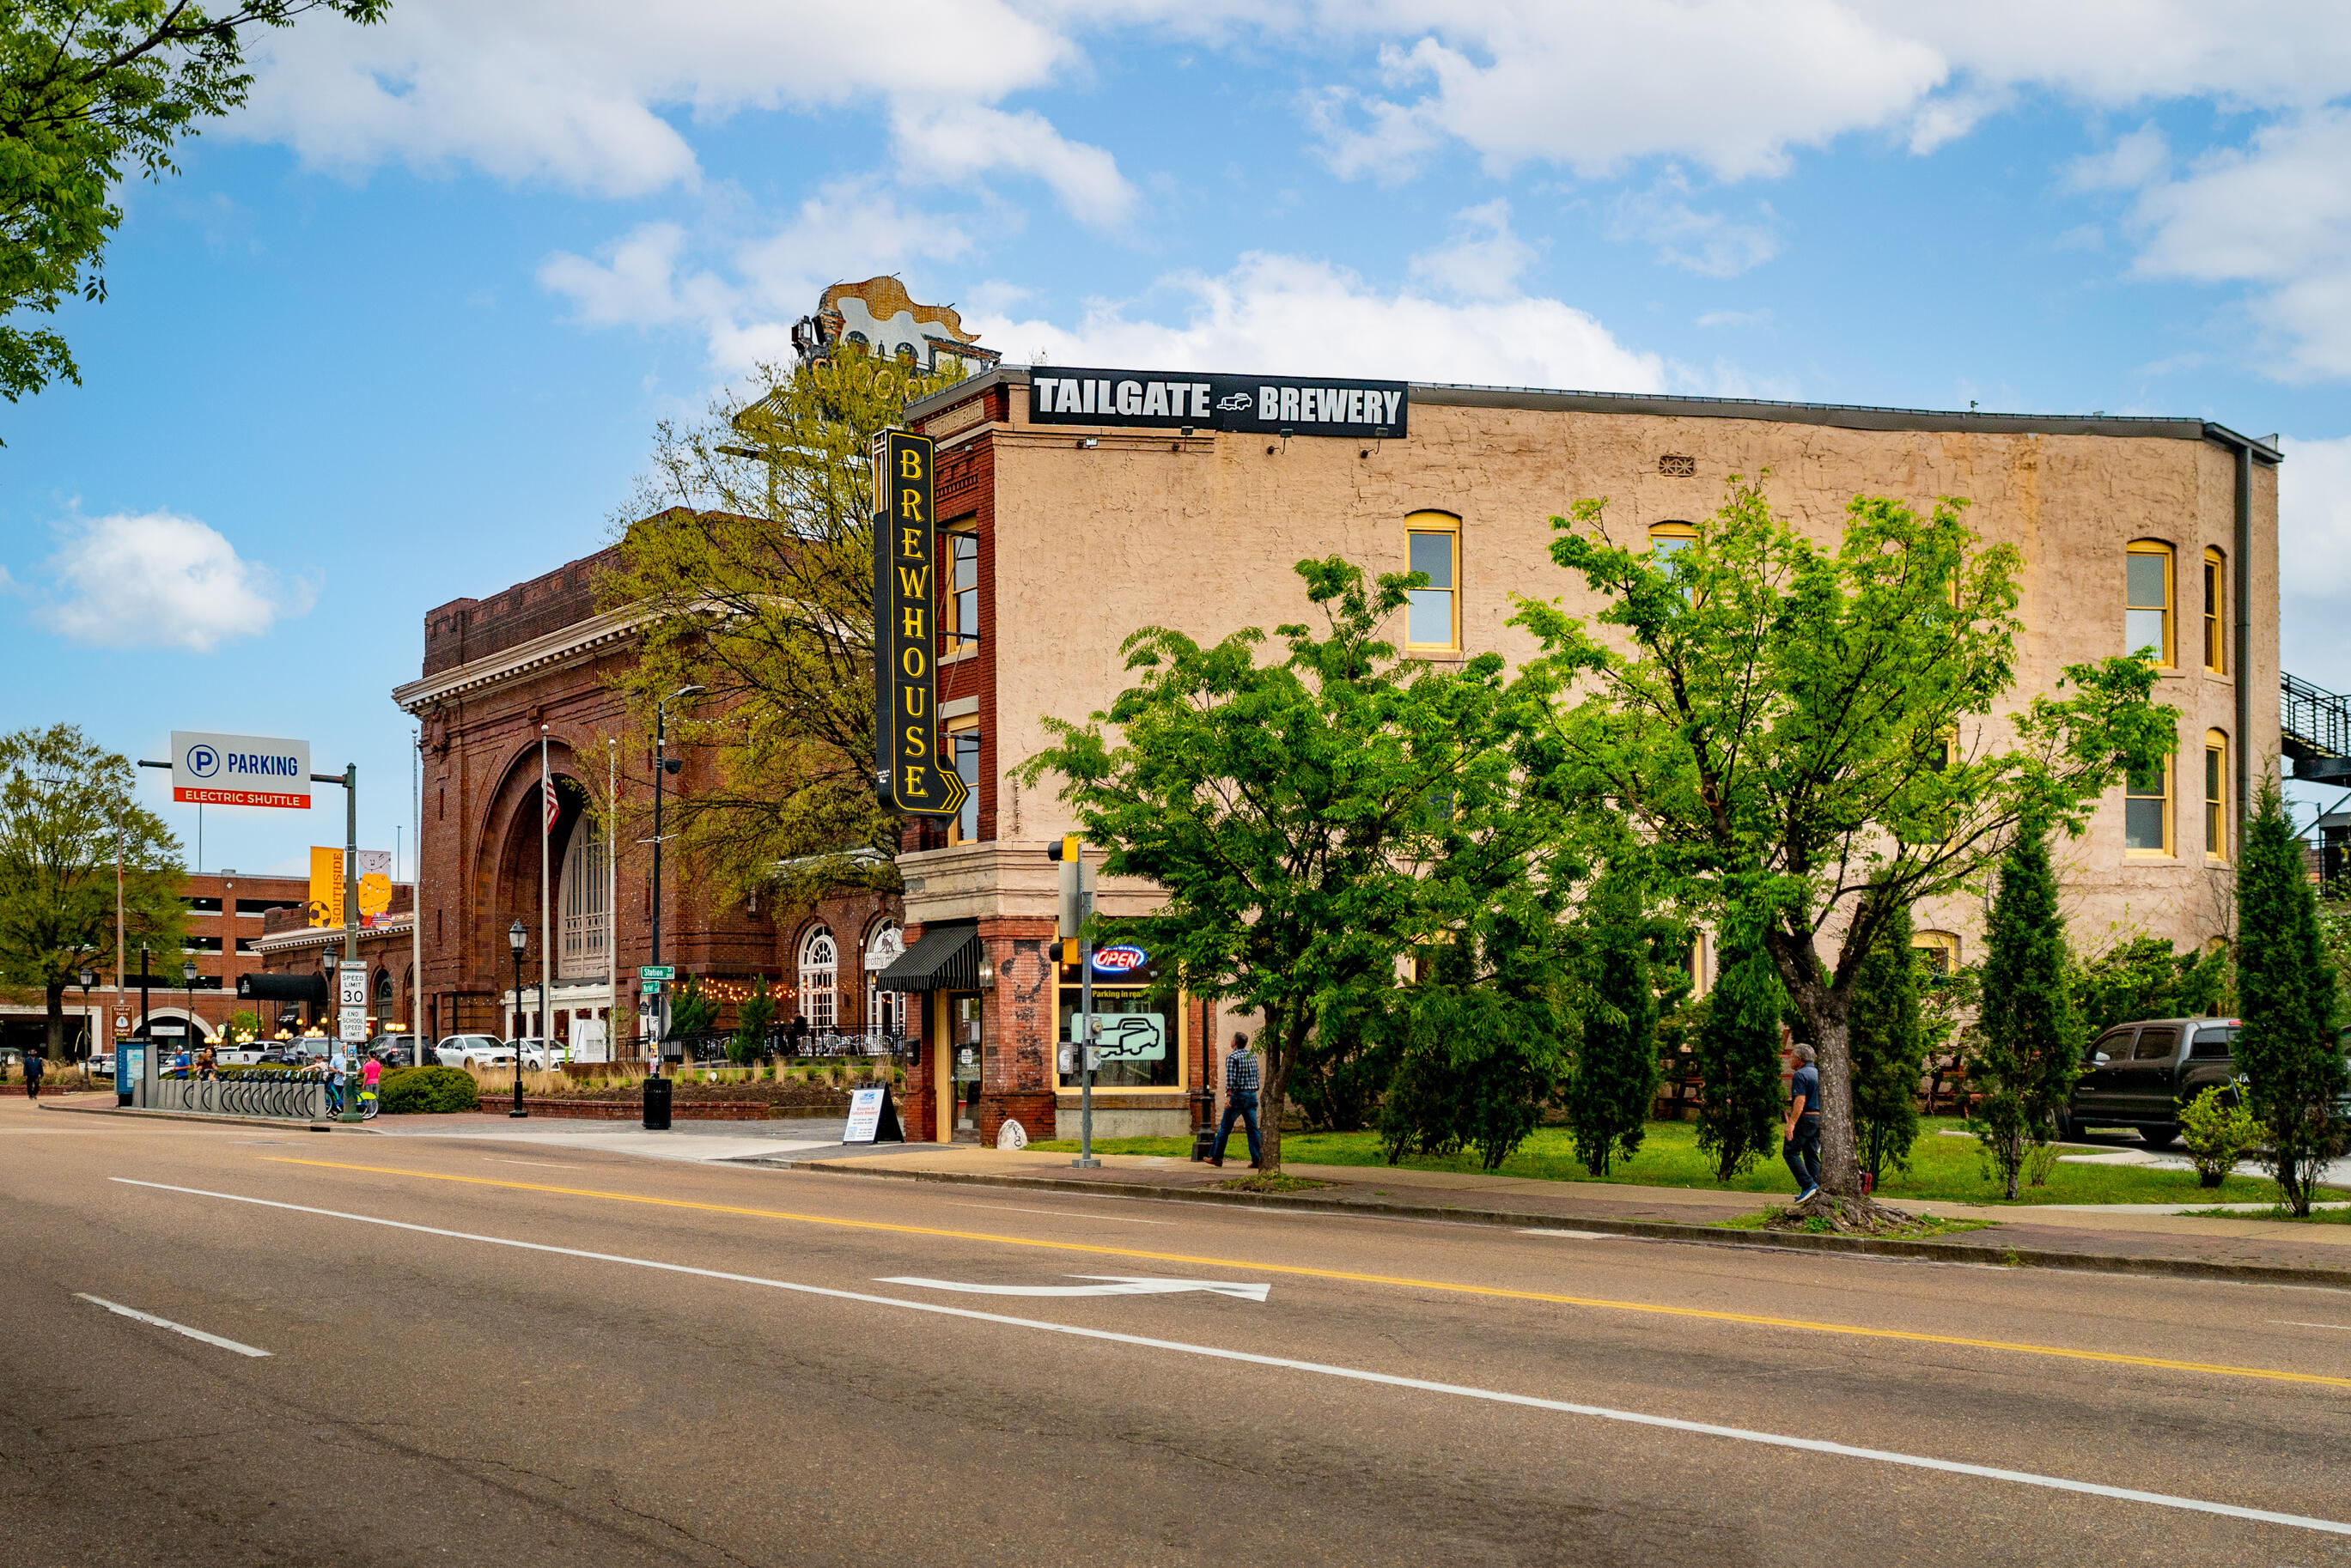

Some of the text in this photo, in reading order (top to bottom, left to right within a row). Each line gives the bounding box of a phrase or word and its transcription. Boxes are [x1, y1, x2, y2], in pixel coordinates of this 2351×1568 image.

[1034, 377, 1402, 424] TAILGATE BREWERY
[898, 449, 929, 798] BREWHOUSE
[228, 753, 298, 776] PARKING
[186, 790, 301, 806] ELECTRIC SHUTTLE
[332, 853, 343, 924] SOUTHSIDE
[1096, 950, 1139, 968] OPEN
[644, 968, 664, 977] Station
[343, 990, 363, 1003] 30
[1092, 989, 1120, 999] Parking
